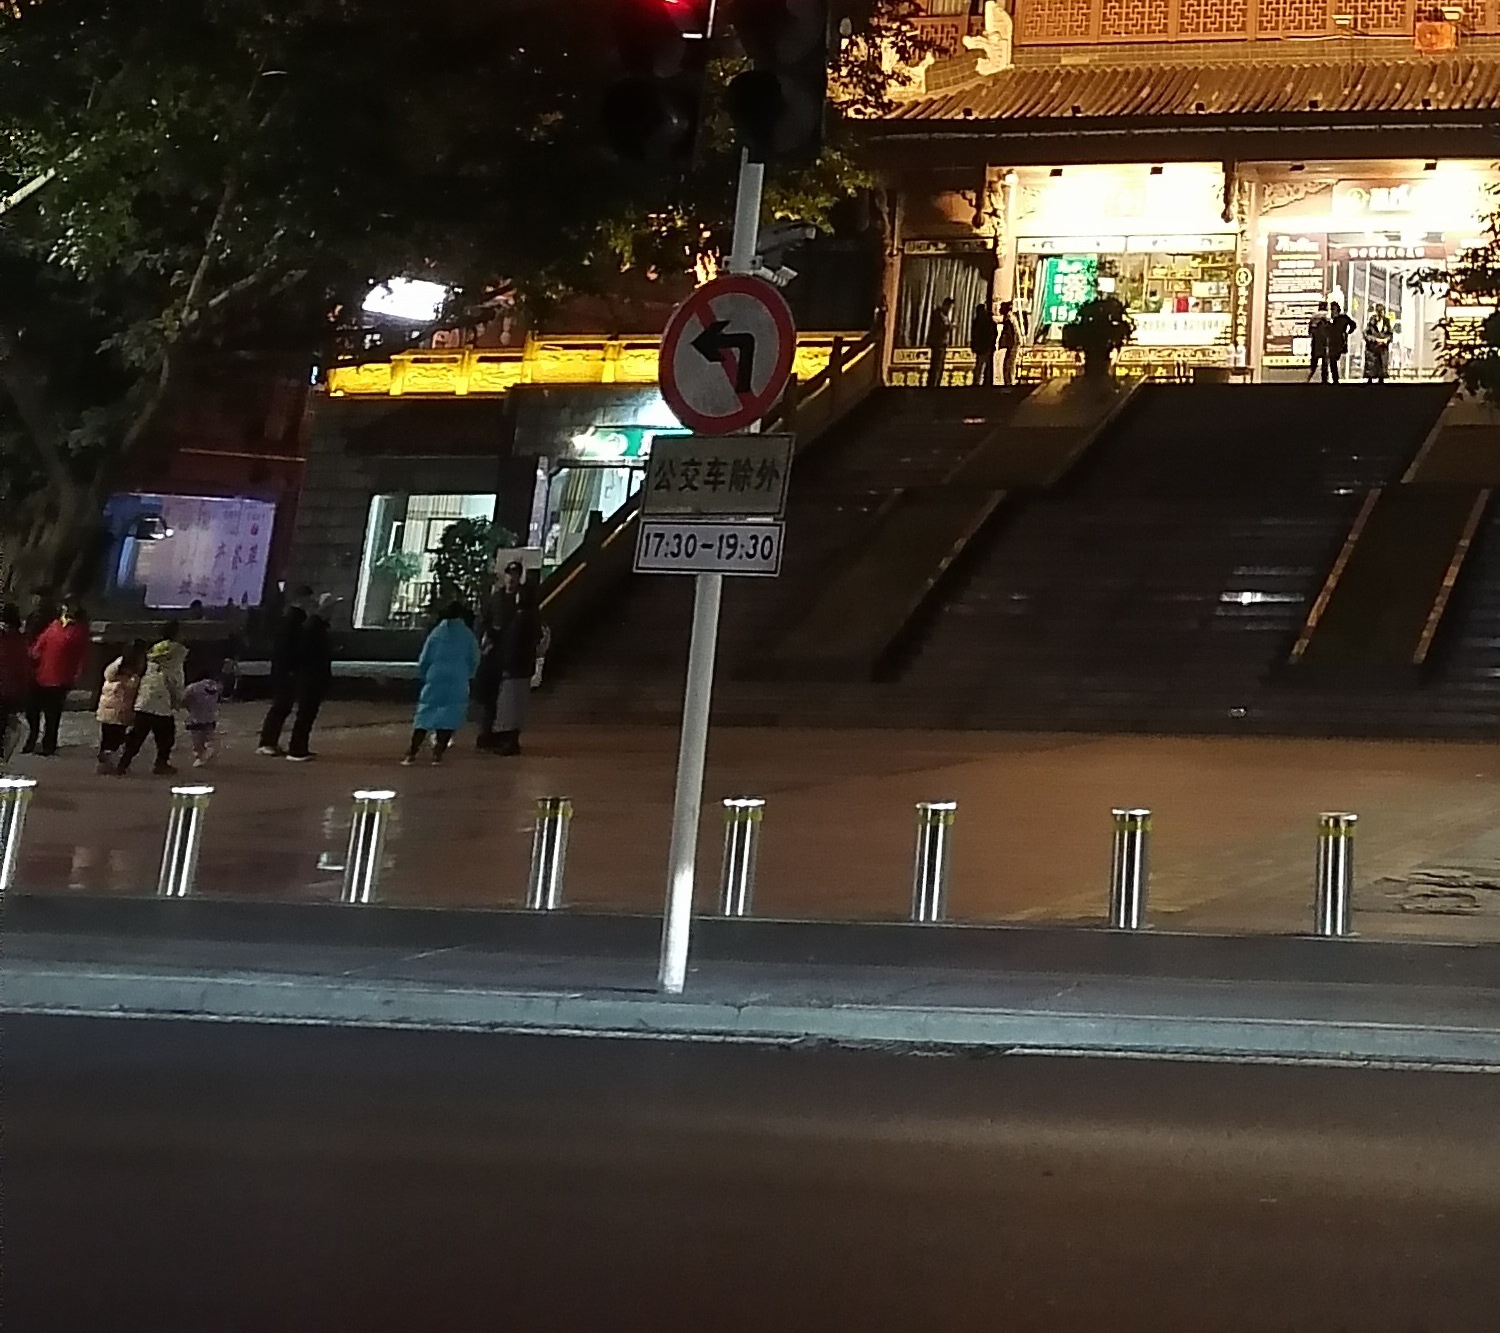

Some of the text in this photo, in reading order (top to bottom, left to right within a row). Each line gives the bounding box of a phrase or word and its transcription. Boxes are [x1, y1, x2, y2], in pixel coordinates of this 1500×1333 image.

[654, 457, 780, 493] 公交车除外
[643, 532, 774, 561] 17:30-19:30
